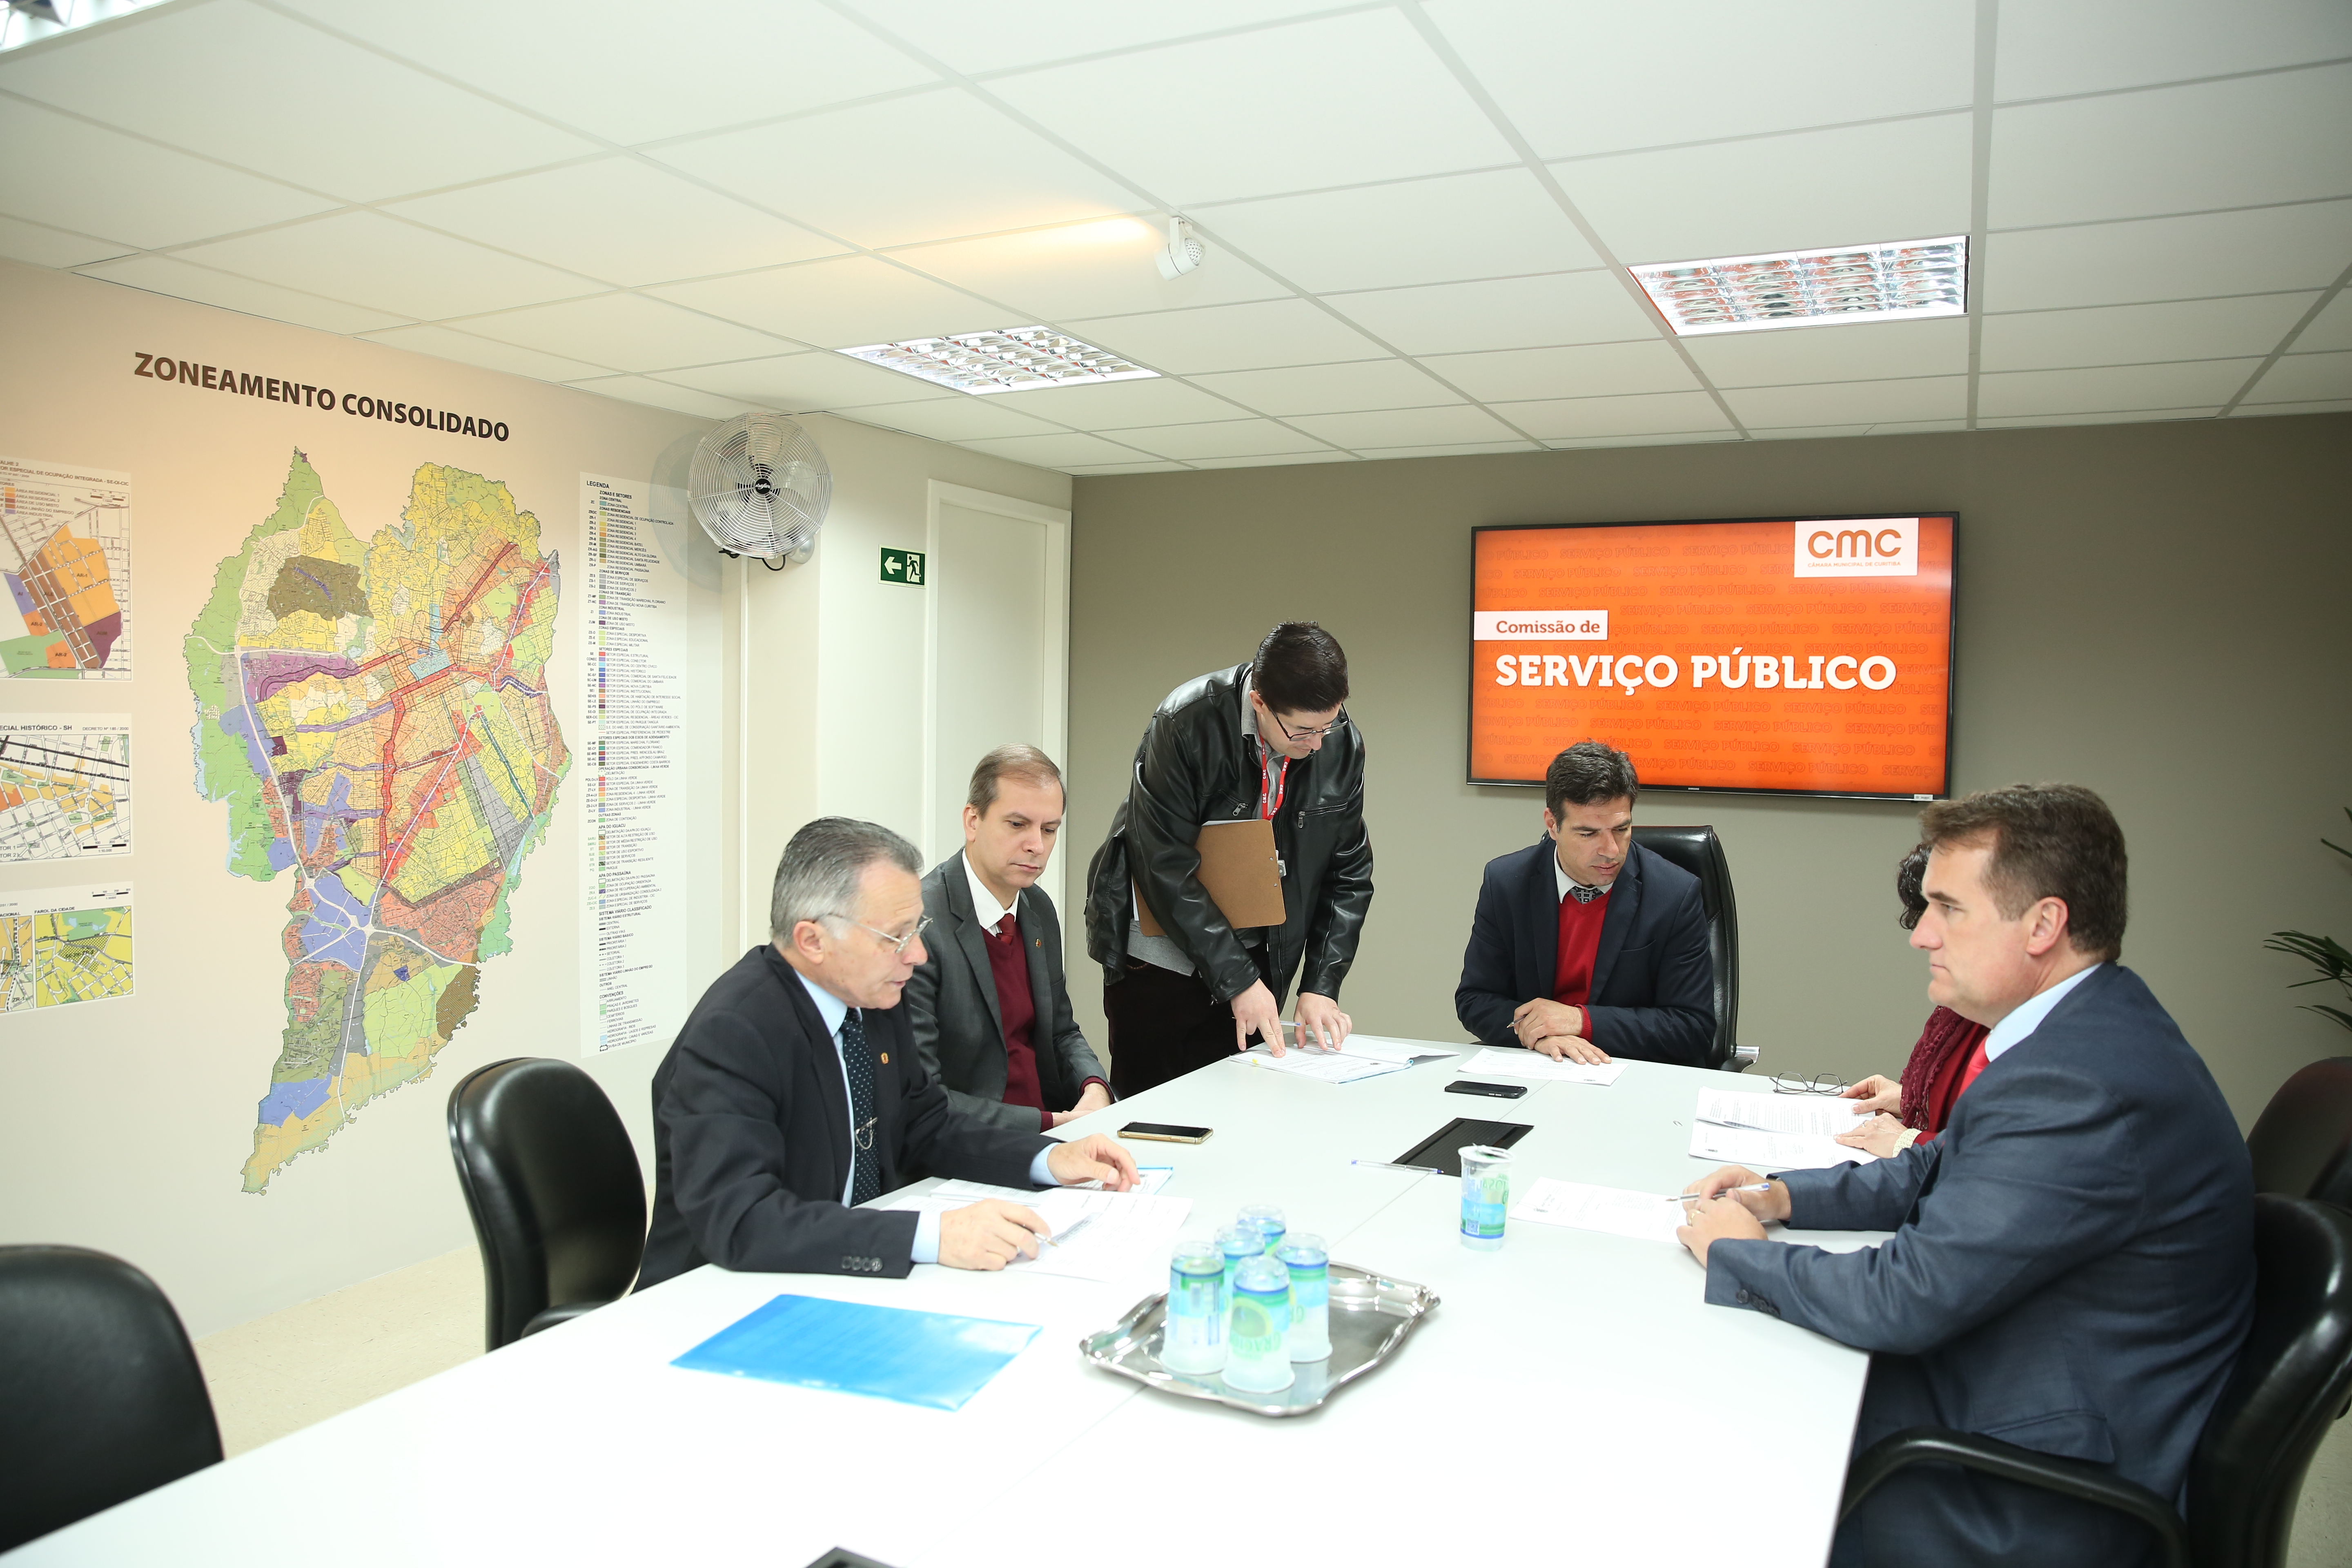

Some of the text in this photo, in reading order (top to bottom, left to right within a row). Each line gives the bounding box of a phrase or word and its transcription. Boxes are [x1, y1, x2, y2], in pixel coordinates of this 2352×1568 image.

[134, 352, 509, 441] ZONEAMENTO CONSOLIDADO
[587, 480, 610, 489] LEGENDA
[1539, 587, 1590, 599] SERVIÇO
[1594, 584, 1647, 596] PÚBLICO
[1660, 586, 1715, 597] SERVIÇO
[1718, 583, 1775, 595] PÚBLICO
[1788, 584, 1846, 596] SERVIÇO
[1621, 605, 1674, 617] SERVIÇO
[1677, 602, 1733, 615] PÚBLICO
[1746, 604, 1803, 617] SERVIÇO
[1806, 601, 1866, 614] PÚBLICO
[1497, 620, 1599, 633] Comissão de
[1495, 646, 1897, 696] SERVIÇO PÚBLICO
[1536, 697, 1906, 715] SERVIÇO PÚBLICO SERVIÇO PÚBLICO SERVIÇO PÚBLICO
[1590, 719, 1643, 731] SERVIÇO
[1646, 717, 1701, 730] PÚBLICO
[1715, 721, 1770, 734] SERVIÇO
[1773, 719, 1832, 733] PÚBLICO
[599, 991, 624, 999] CONVENÇÕES
